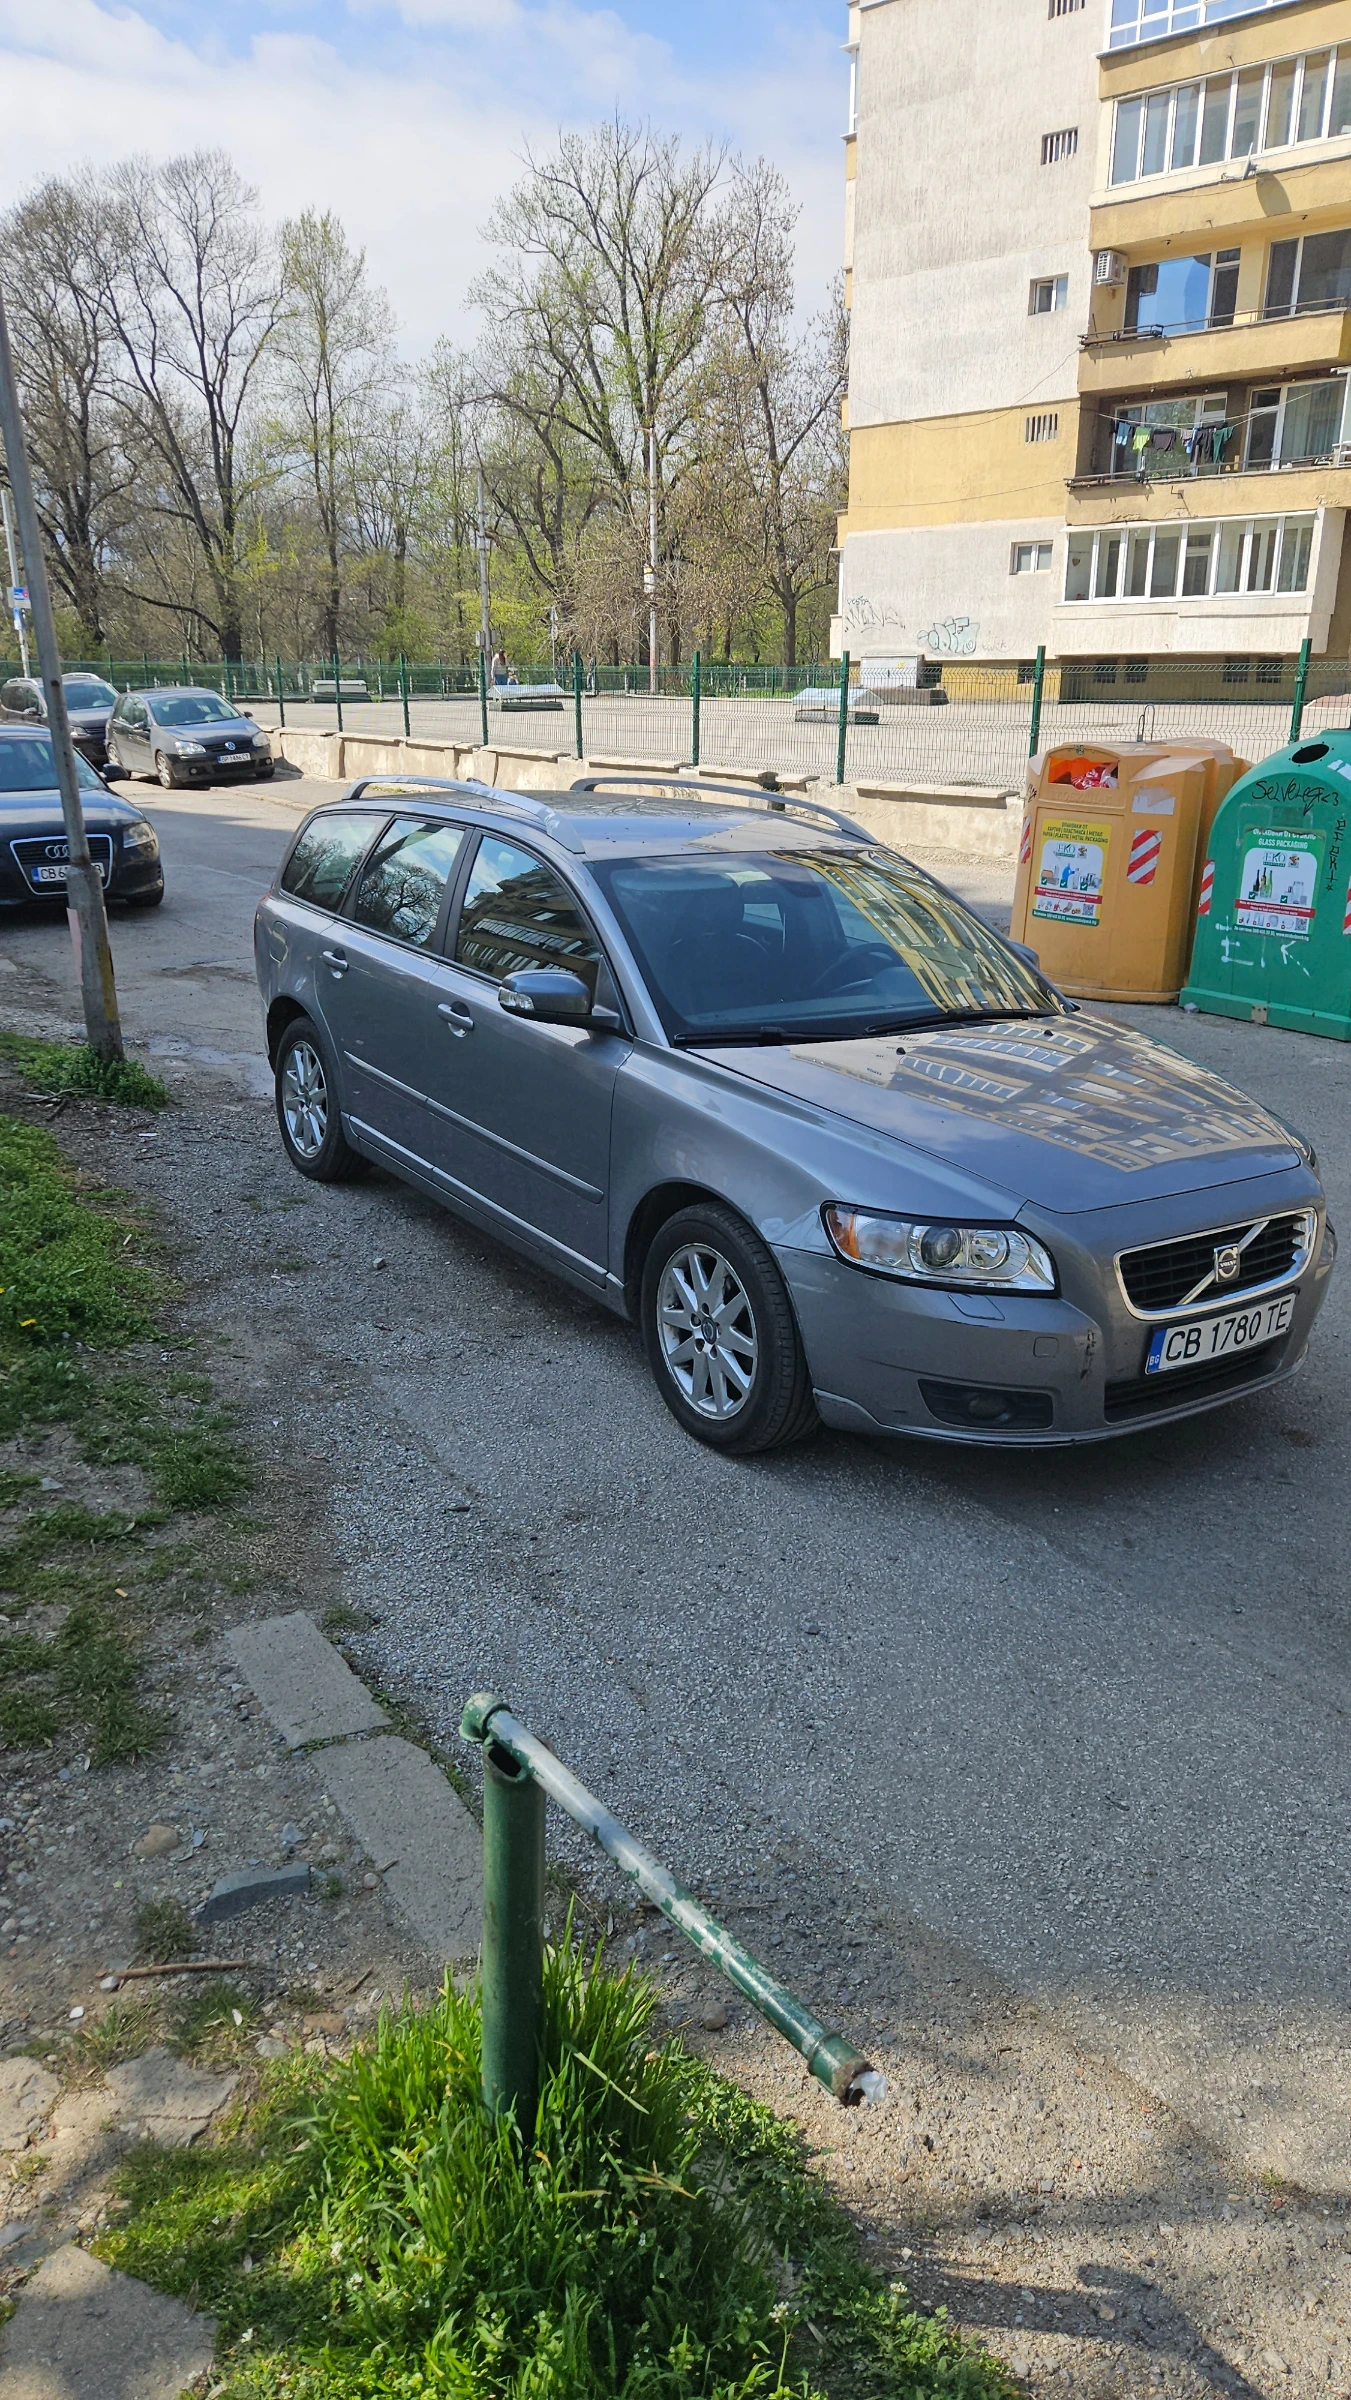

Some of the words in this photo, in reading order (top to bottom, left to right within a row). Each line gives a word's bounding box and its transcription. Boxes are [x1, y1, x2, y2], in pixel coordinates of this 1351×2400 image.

[1258, 838, 1276, 847] GLASS
[1276, 840, 1308, 849] PACKAGING
[1166, 1328, 1202, 1361] CB
[1211, 1310, 1262, 1353] 1780
[1267, 1298, 1291, 1334] TE
[1149, 1354, 1160, 1366] BG
